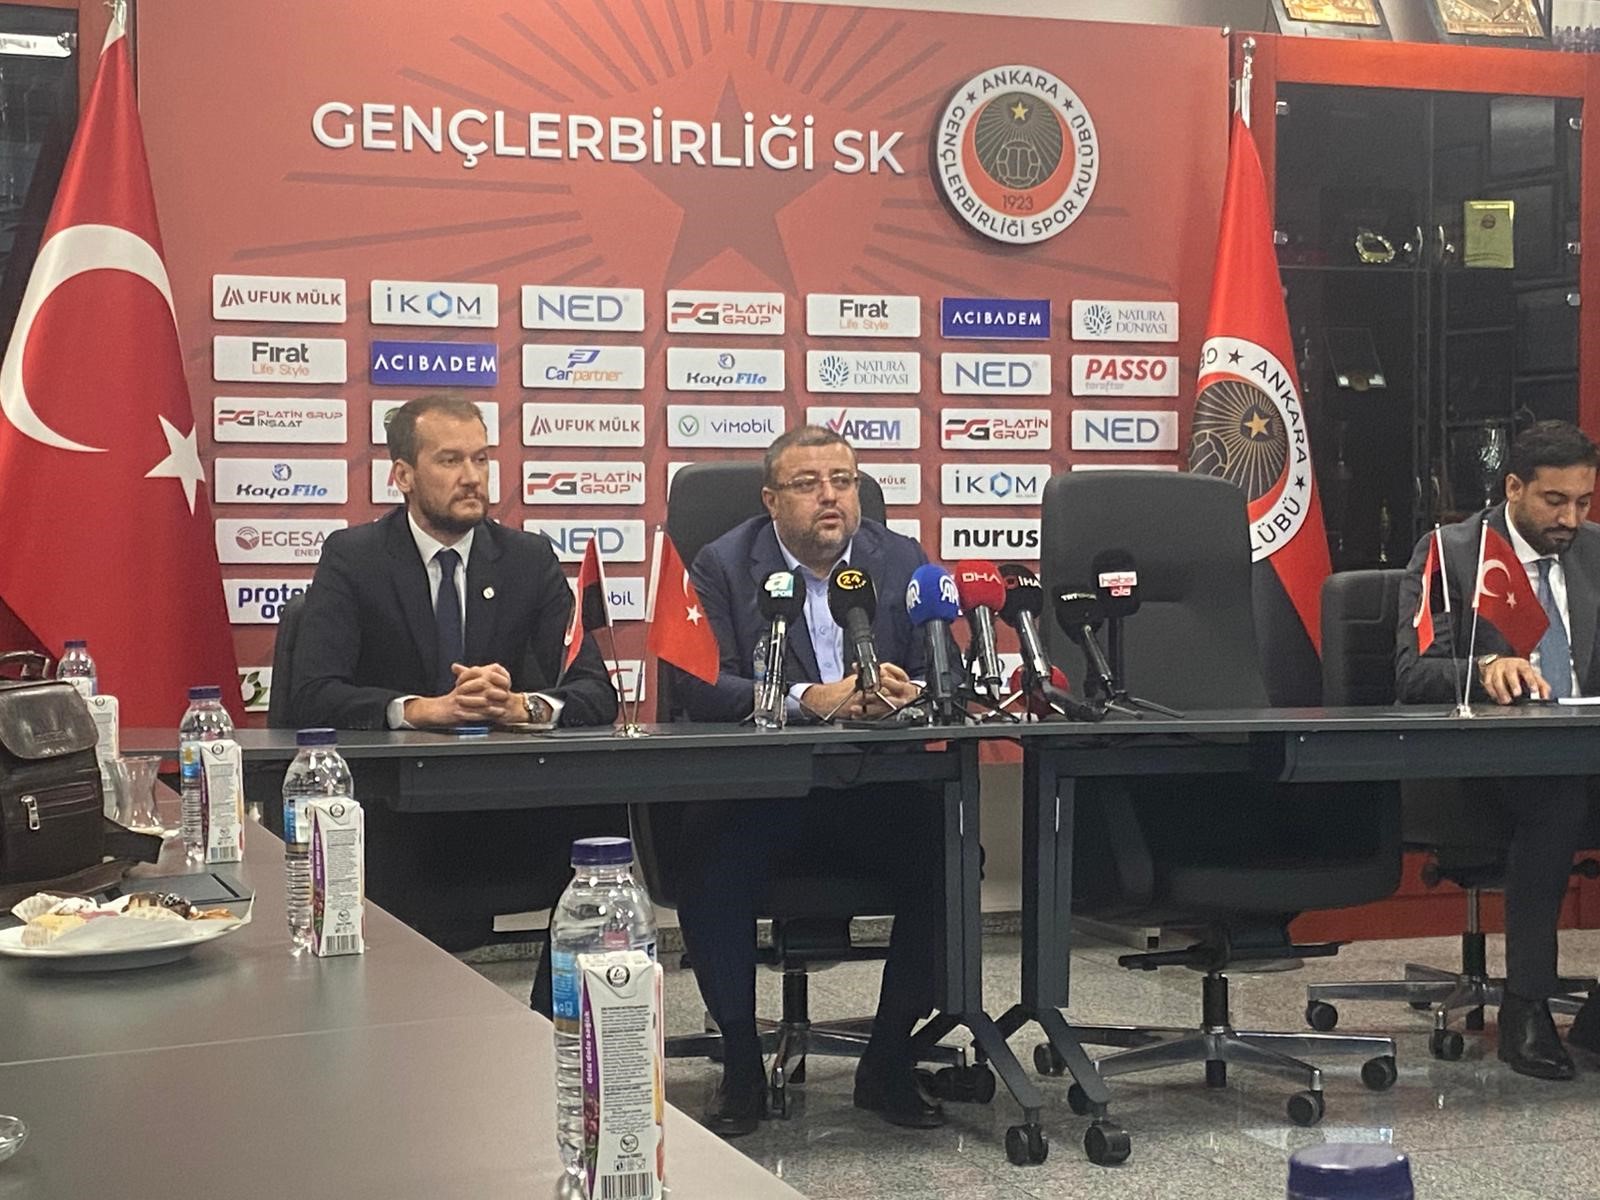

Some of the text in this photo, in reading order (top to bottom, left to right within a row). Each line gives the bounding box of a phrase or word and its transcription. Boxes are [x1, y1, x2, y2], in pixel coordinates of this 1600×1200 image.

[982, 70, 1060, 99] ANKARA
[311, 101, 905, 174] GENÇLERBİRLİĞİ SK
[940, 105, 1094, 237] GENÇLERBİRLİĞİ SPOR KULÜBÜ
[1002, 195, 1033, 210] 1923
[247, 289, 341, 306] UFUK MÜLK
[537, 294, 623, 322] NED
[722, 302, 782, 315] PLATİN
[1118, 309, 1165, 321] NATURA
[722, 315, 772, 325] GRUP
[952, 311, 1041, 326] ACIBADEM
[1116, 322, 1168, 335] DÜNYASI
[374, 354, 497, 373] ACIBADEM
[856, 360, 906, 372] NATURA
[1085, 359, 1167, 381] PASSO
[854, 372, 909, 385] DÜNYASI
[956, 361, 1032, 387] NED
[257, 410, 343, 419] PLATİN GRUP
[1251, 360, 1307, 464] ANKARA
[555, 416, 640, 432] UFUK MÜLK
[993, 416, 1049, 428] PLATİN
[993, 430, 1039, 439] GRUP
[1085, 418, 1159, 443] NED
[580, 471, 642, 483] PLATİN
[879, 476, 906, 485] MÜLK
[580, 484, 631, 494] GRUP
[262, 531, 325, 547] EGESA
[953, 529, 1039, 548] nurus
[294, 549, 320, 557] ENER
[962, 572, 1001, 585] DHA
